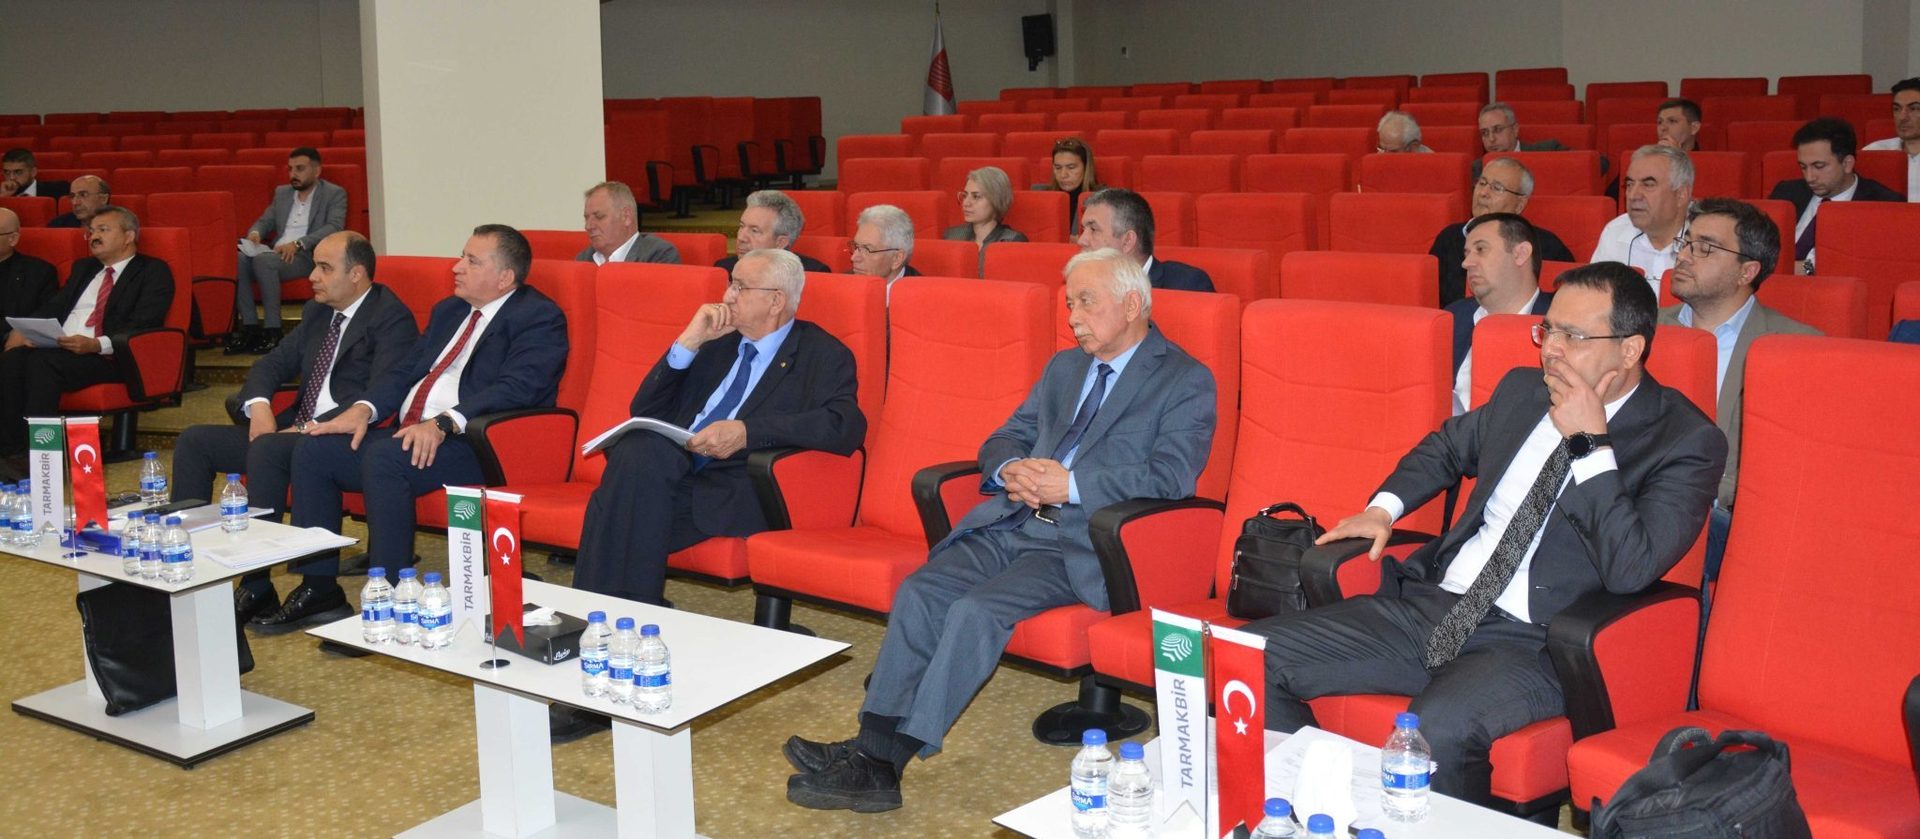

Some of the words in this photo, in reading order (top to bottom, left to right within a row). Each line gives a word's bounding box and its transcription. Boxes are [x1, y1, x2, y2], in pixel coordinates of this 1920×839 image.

[39, 452, 52, 516] TARMAKBİR
[460, 531, 474, 612] TARMAKBİR
[1171, 678, 1193, 788] TARMAKBİR
